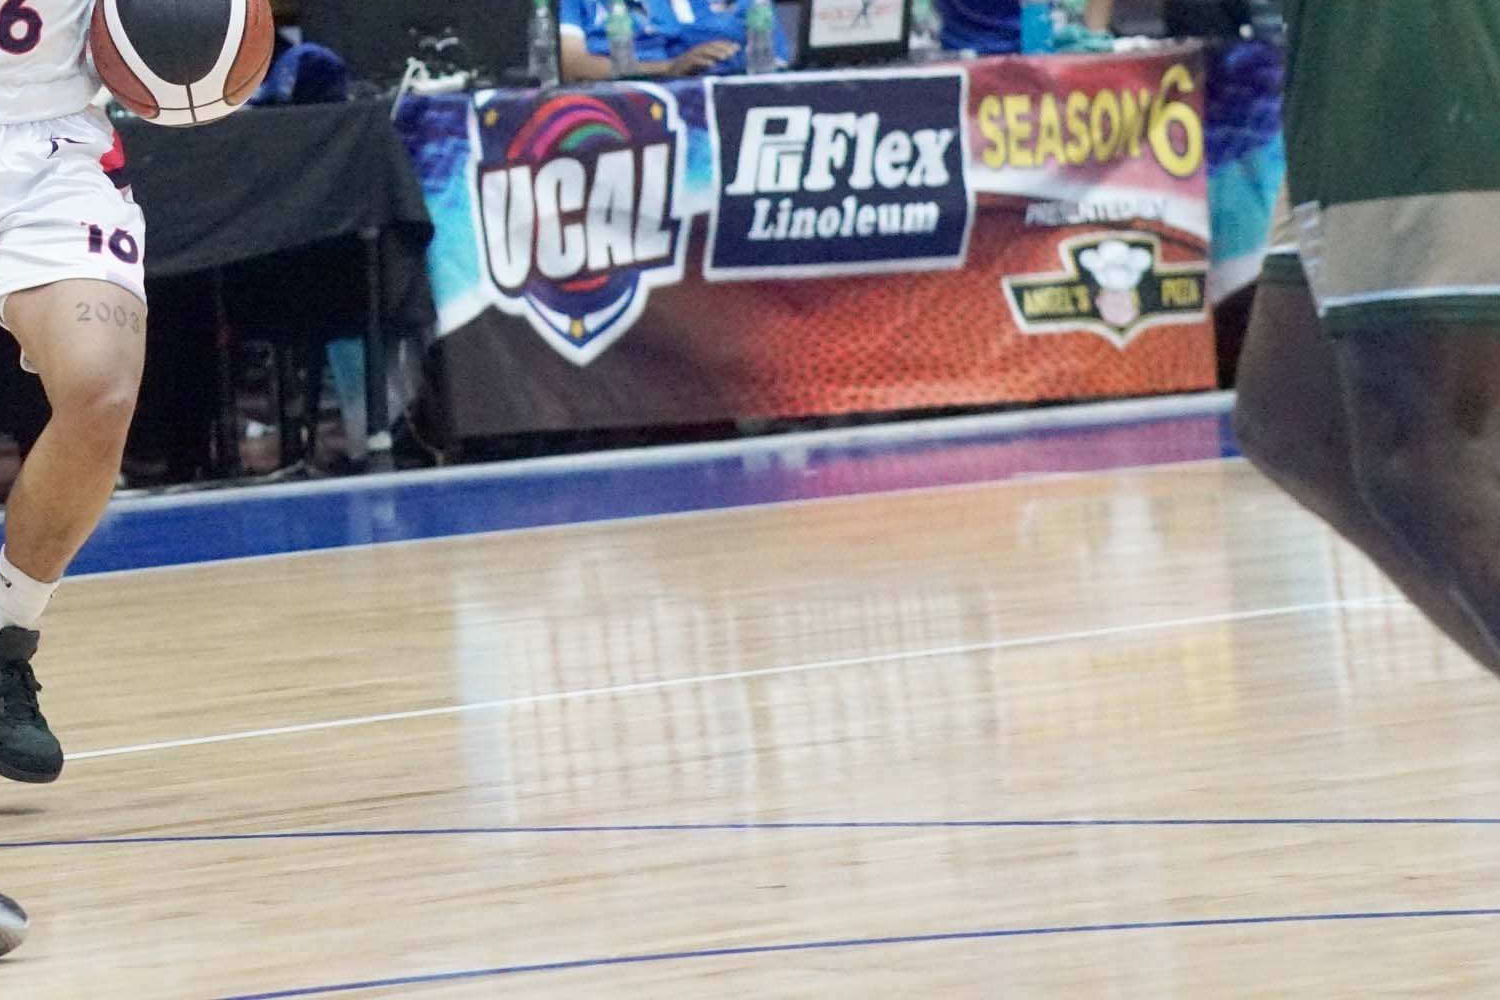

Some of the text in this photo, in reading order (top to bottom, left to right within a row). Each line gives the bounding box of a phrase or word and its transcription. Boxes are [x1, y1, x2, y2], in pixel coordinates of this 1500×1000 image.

[979, 63, 1203, 178] SEASON 6
[481, 142, 673, 289] UCAL
[747, 195, 940, 240] Linoleum
